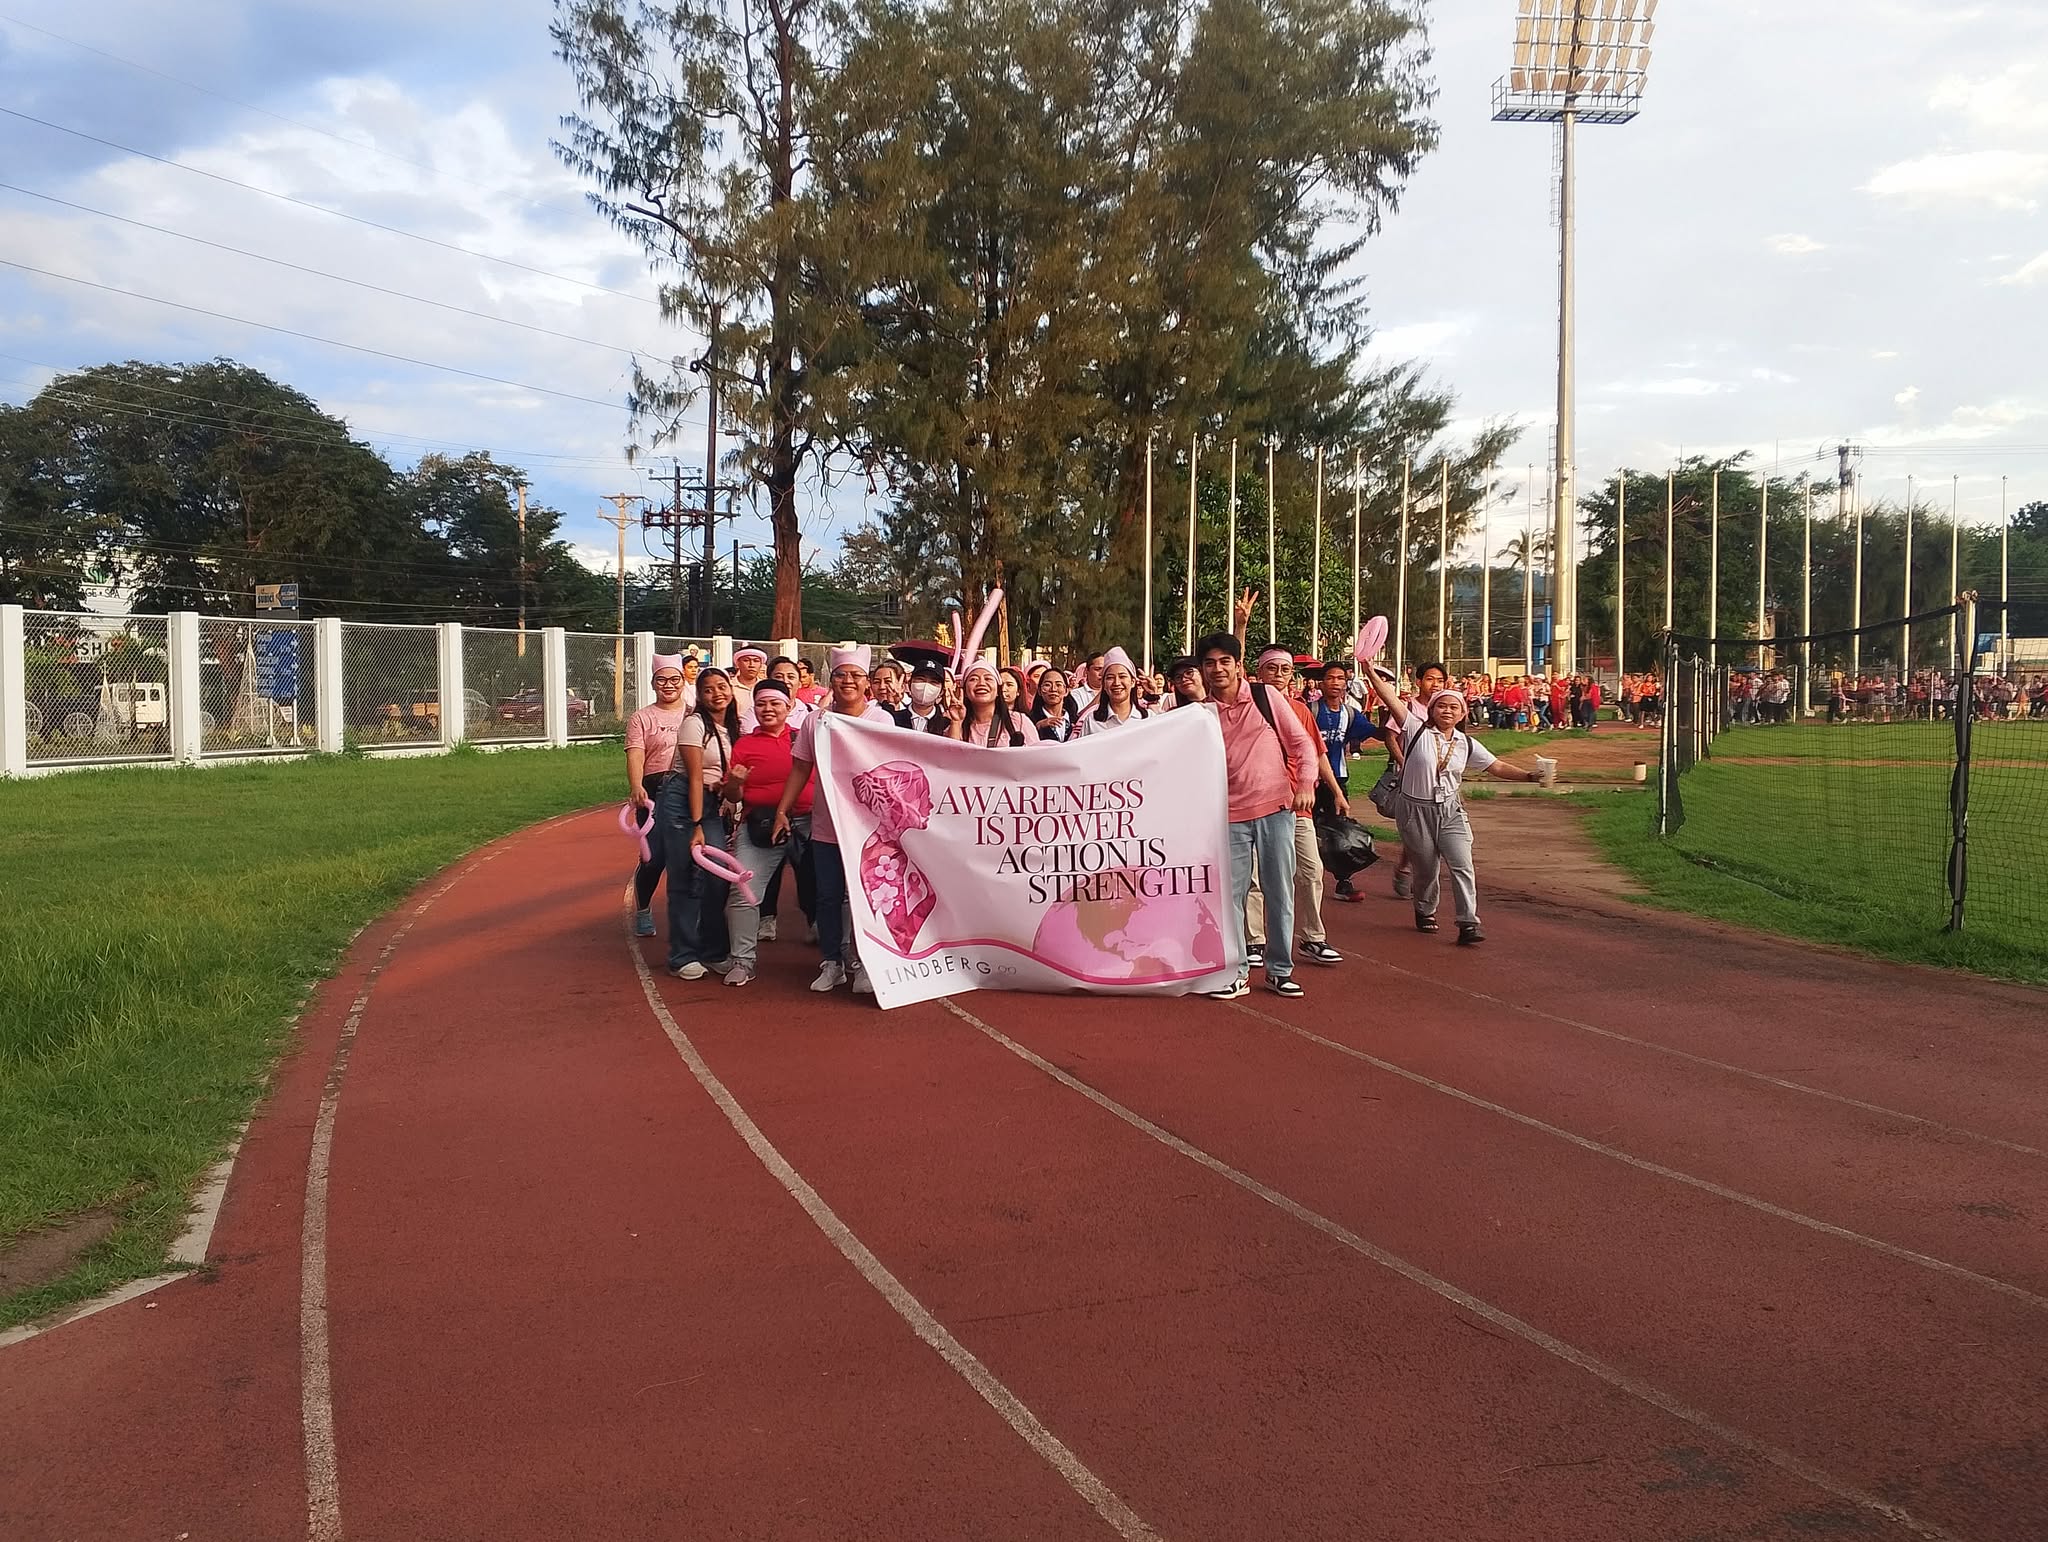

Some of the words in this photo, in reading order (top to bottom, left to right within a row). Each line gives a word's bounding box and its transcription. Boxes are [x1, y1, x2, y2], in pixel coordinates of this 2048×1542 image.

[936, 779, 1144, 815] AWARENESS
[975, 816, 1005, 846] IS
[1013, 811, 1139, 845] POWER
[996, 840, 1129, 875] ACTION
[1137, 838, 1167, 867] IS
[1028, 864, 1213, 904] STRENGTH
[886, 955, 992, 985] LINDBERG
